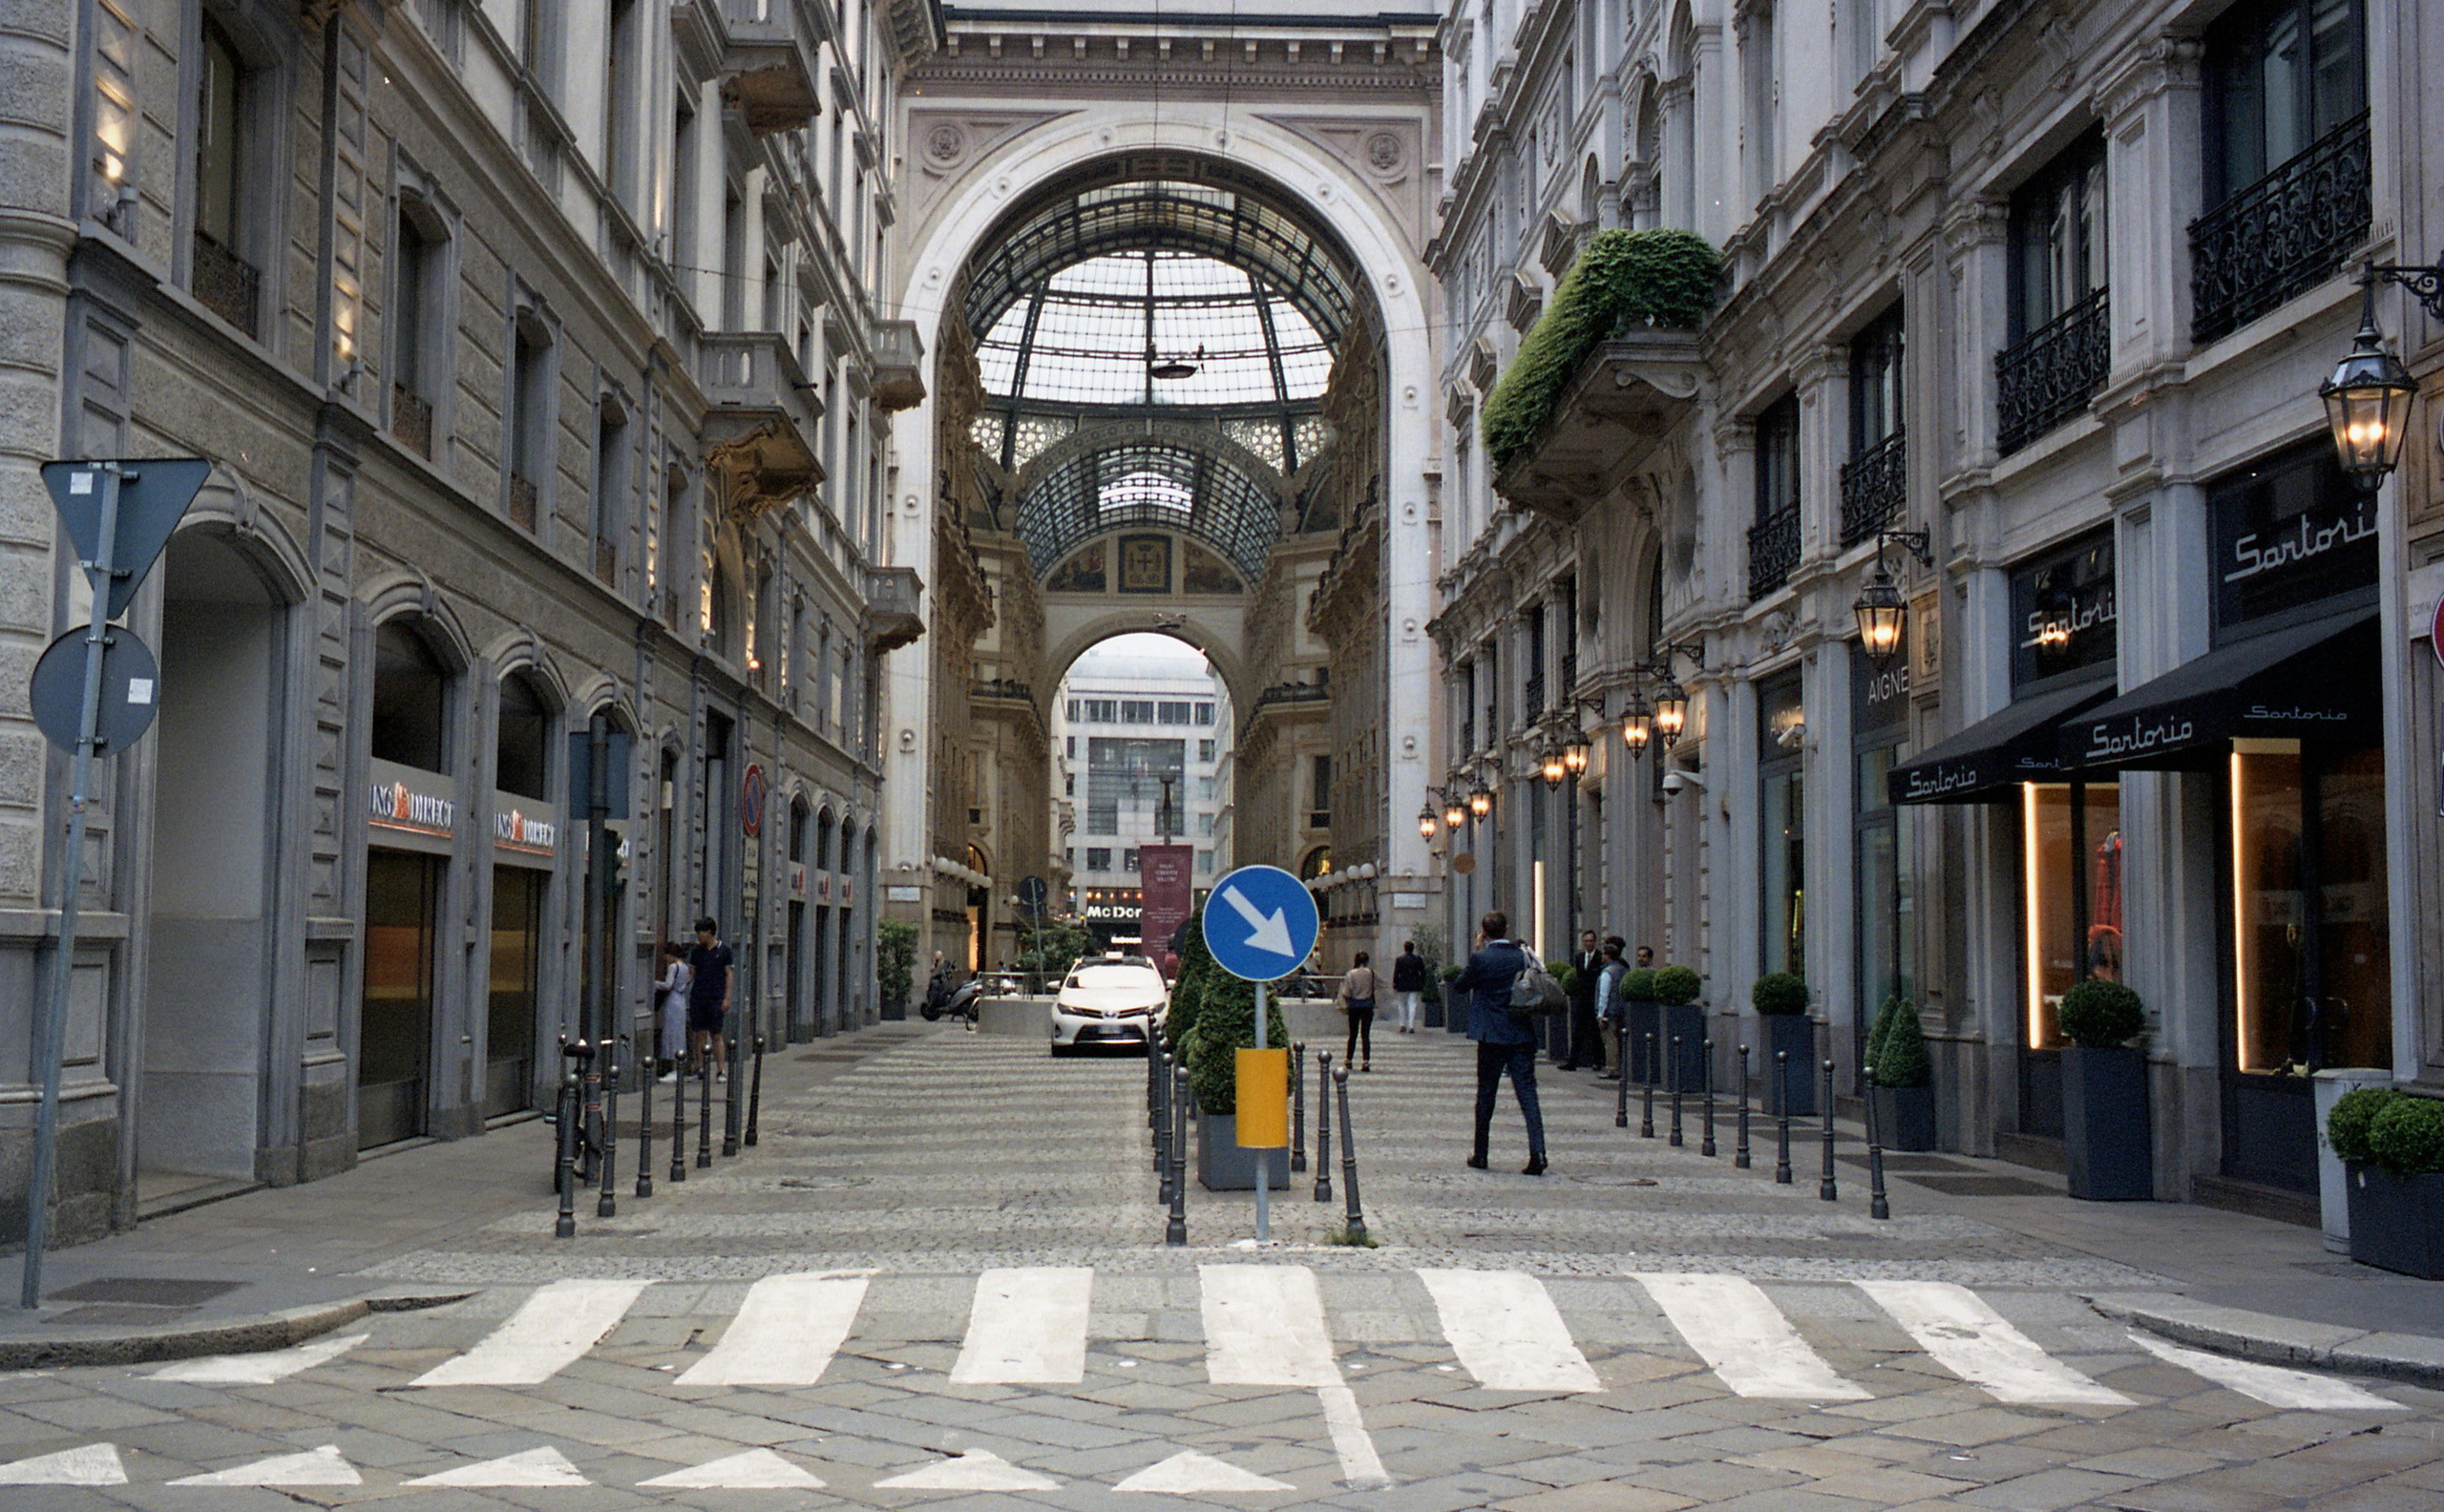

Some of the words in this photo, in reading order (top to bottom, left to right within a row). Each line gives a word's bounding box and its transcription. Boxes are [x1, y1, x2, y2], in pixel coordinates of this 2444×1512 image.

[2224, 502, 2378, 582] Sartori
[2021, 592, 2116, 648] Sartori
[2244, 705, 2348, 720] Sartorio
[2085, 716, 2192, 758] Sartorio
[1906, 765, 1976, 798] Sartorio
[2015, 757, 2060, 769] Sart
[369, 784, 393, 816] ING
[411, 793, 454, 828] DIRECT
[494, 812, 512, 838] ING
[524, 820, 556, 847] DIRECT
